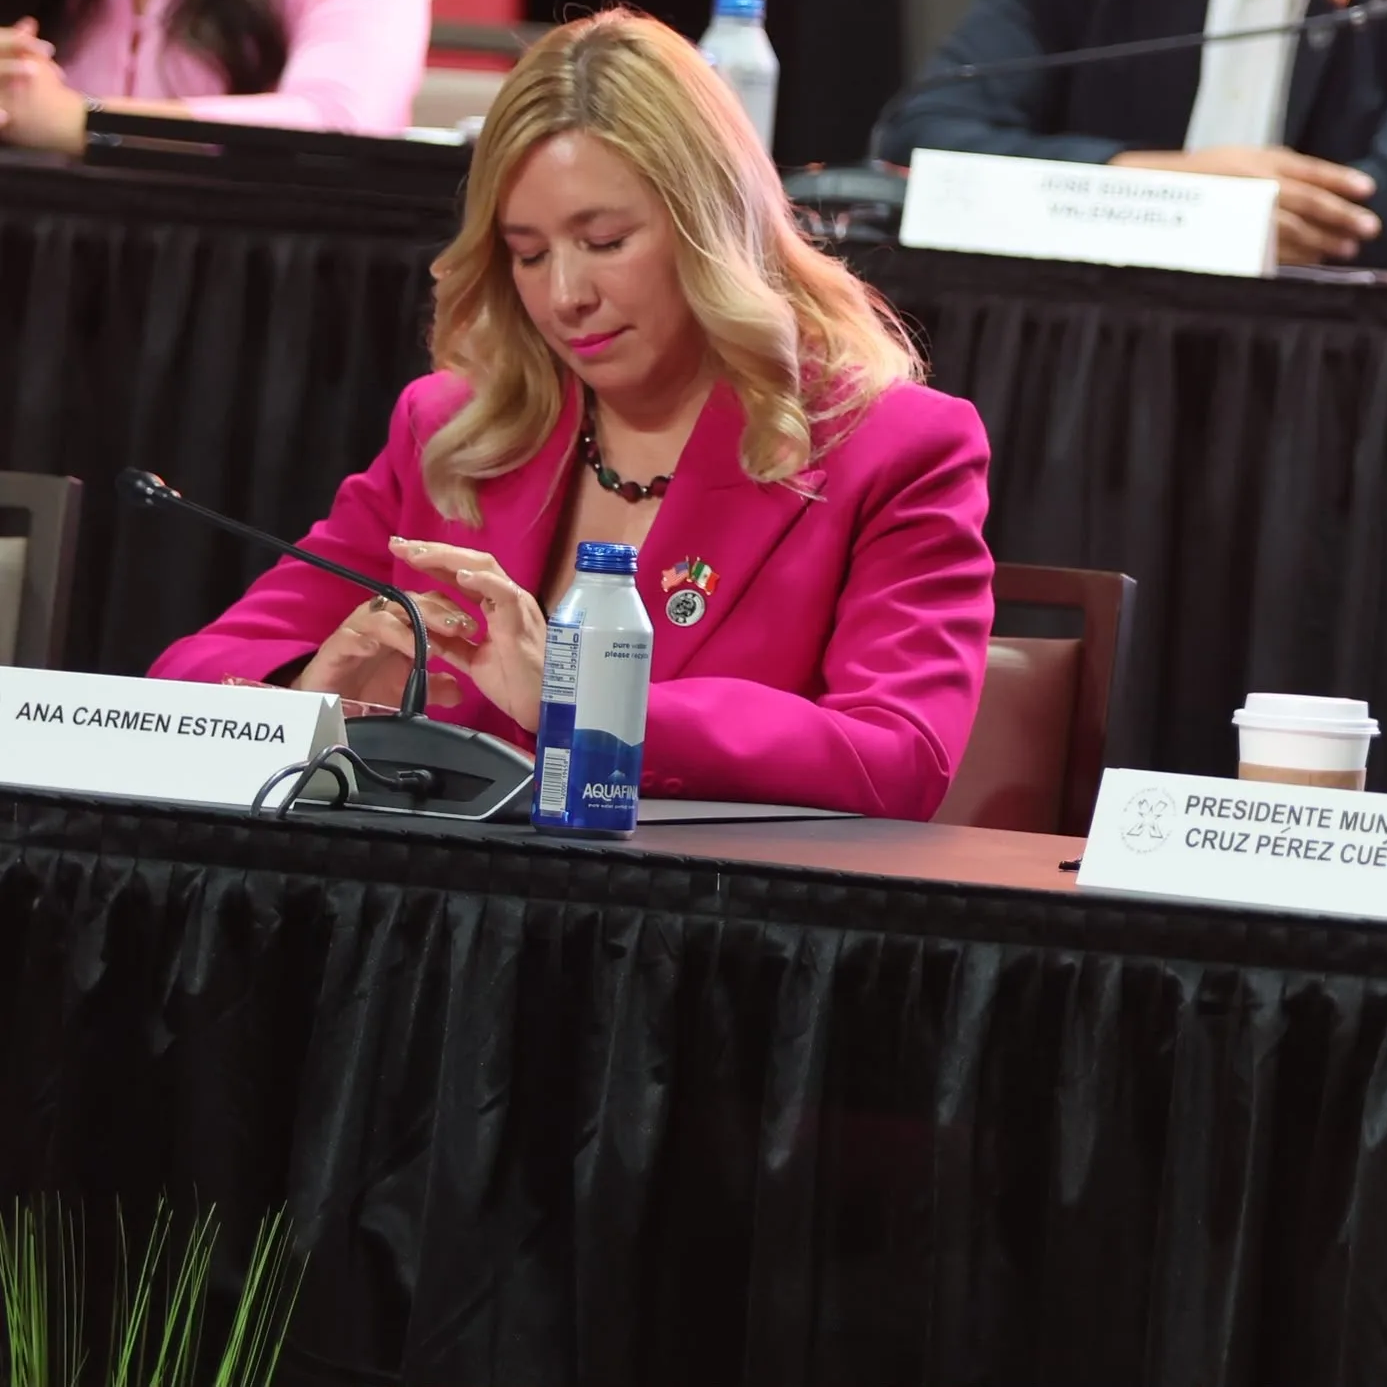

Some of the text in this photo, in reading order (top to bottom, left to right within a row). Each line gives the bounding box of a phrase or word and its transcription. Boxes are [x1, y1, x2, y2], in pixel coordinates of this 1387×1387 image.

[15, 702, 286, 744] ANA CARMEN ESTRADA
[1184, 795, 1332, 829] PRESIDENTE
[1185, 827, 1249, 855] CRUZ
[1256, 826, 1333, 863] PÉREZ
